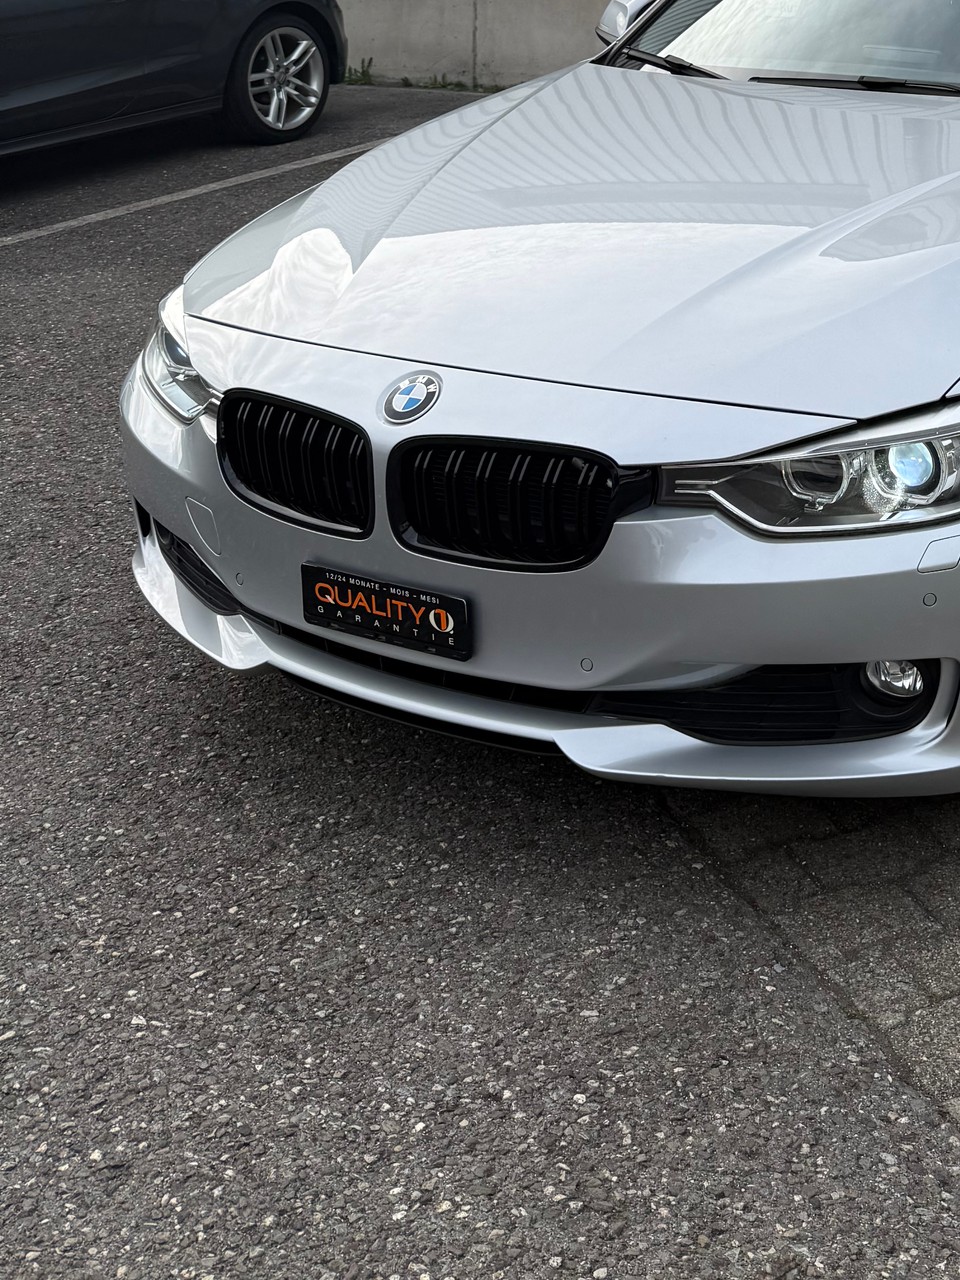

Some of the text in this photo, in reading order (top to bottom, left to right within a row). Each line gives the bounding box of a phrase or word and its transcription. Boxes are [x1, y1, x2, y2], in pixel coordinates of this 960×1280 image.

[314, 582, 426, 625] QUALITY
[325, 572, 347, 582] 12/24
[350, 577, 380, 591] MONATE
[390, 587, 410, 598] MOIS
[420, 594, 440, 605] MESI
[317, 605, 455, 646] GARANTIE
